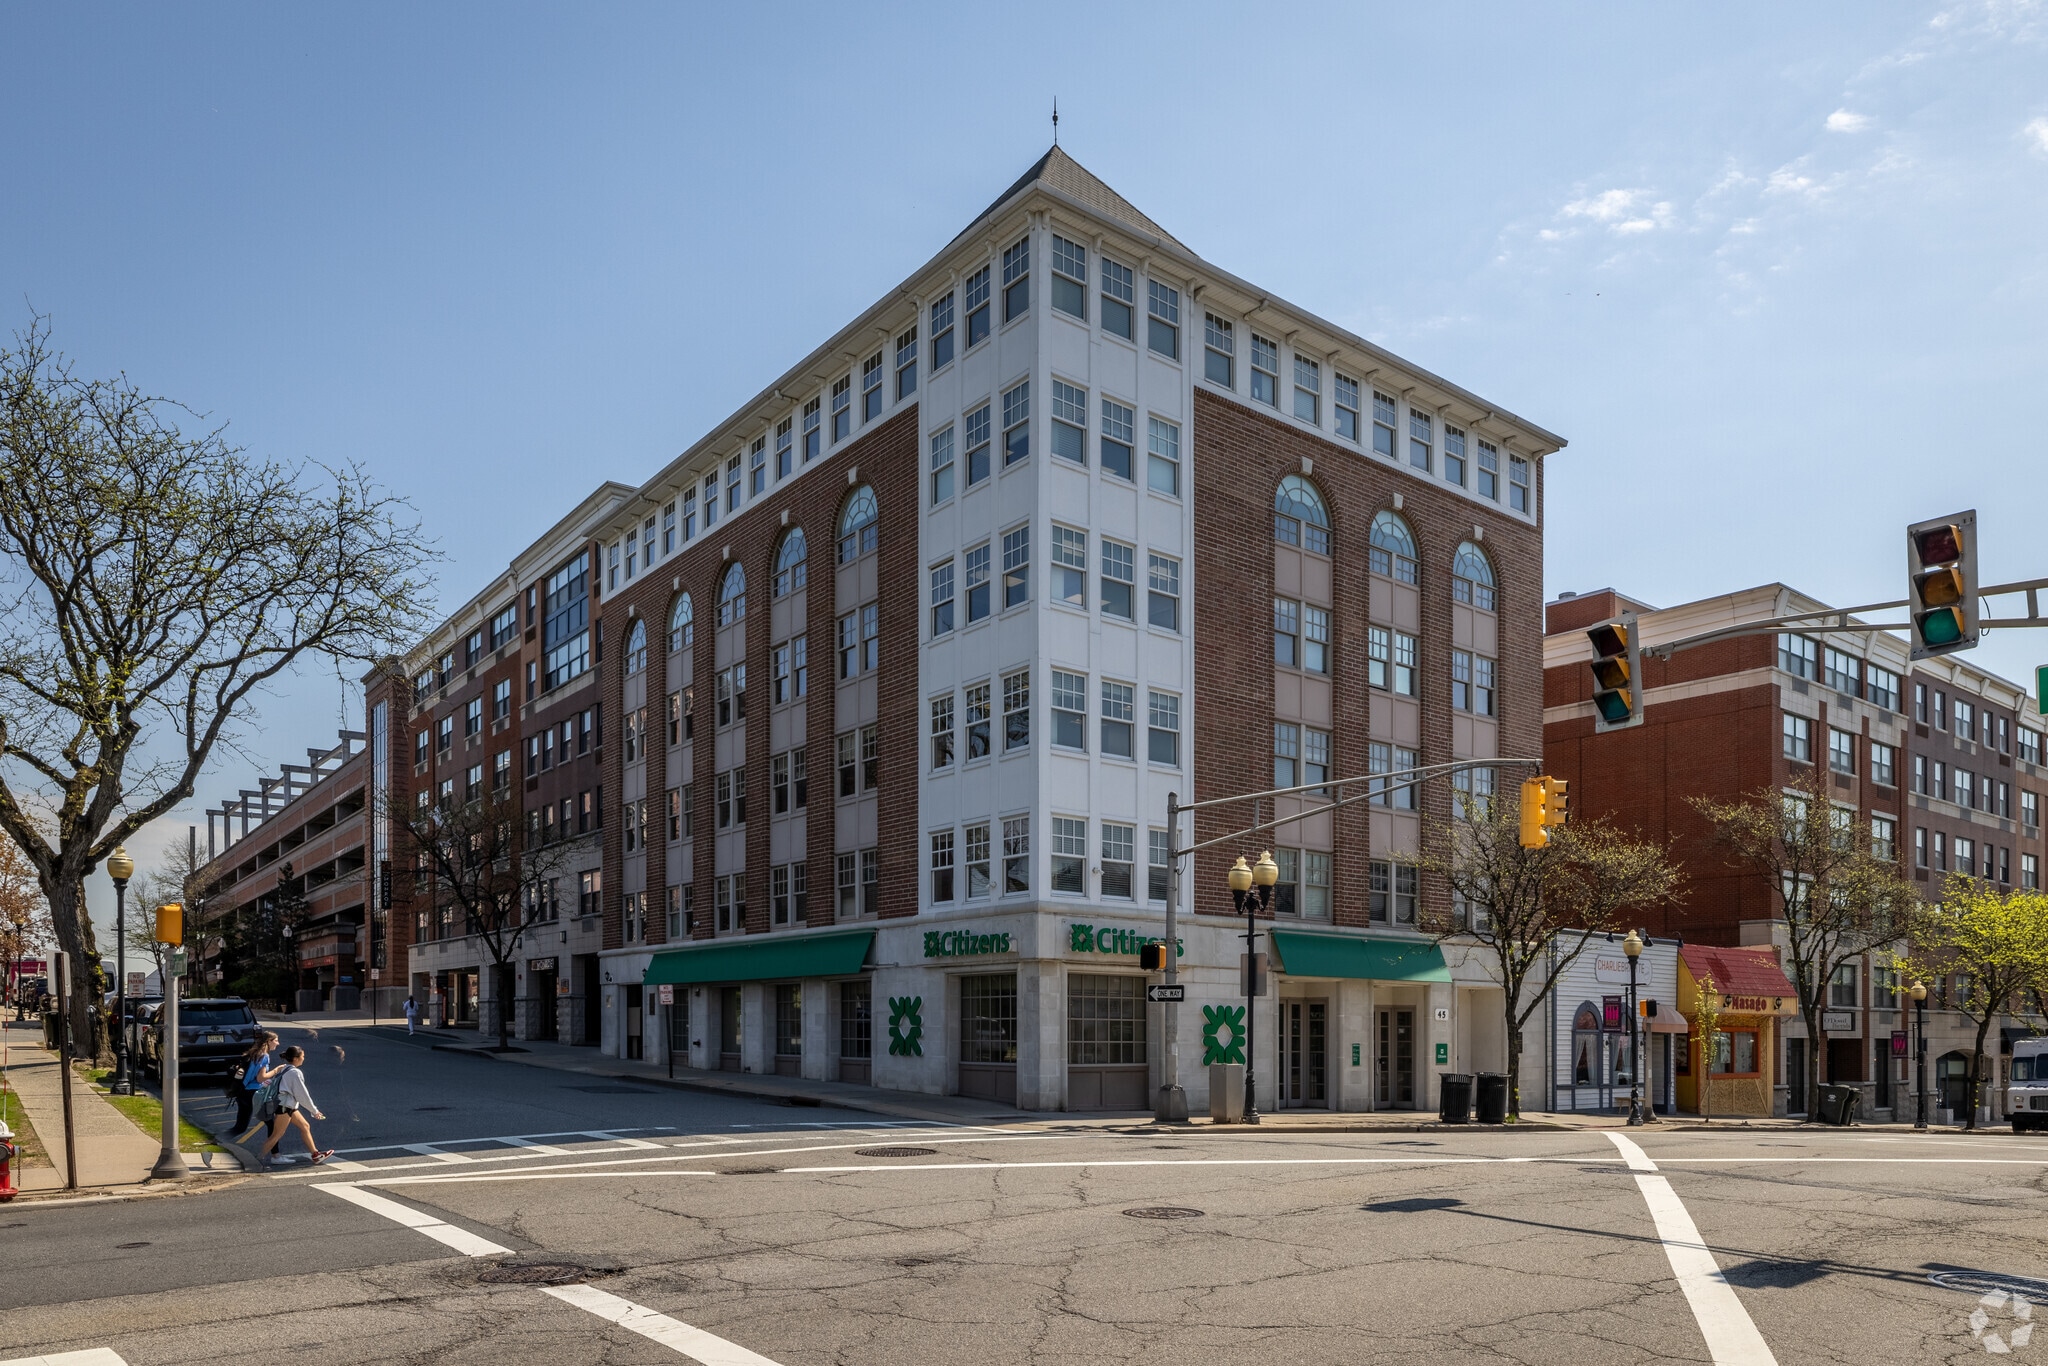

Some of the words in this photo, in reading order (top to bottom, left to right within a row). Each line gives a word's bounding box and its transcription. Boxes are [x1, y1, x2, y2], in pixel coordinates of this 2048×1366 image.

[941, 929, 1010, 956] Citizens
[1096, 928, 1184, 957] Citizs
[1169, 989, 1181, 997] WAY
[1731, 996, 1767, 1011] Masago
[1437, 1010, 1446, 1019] 45
